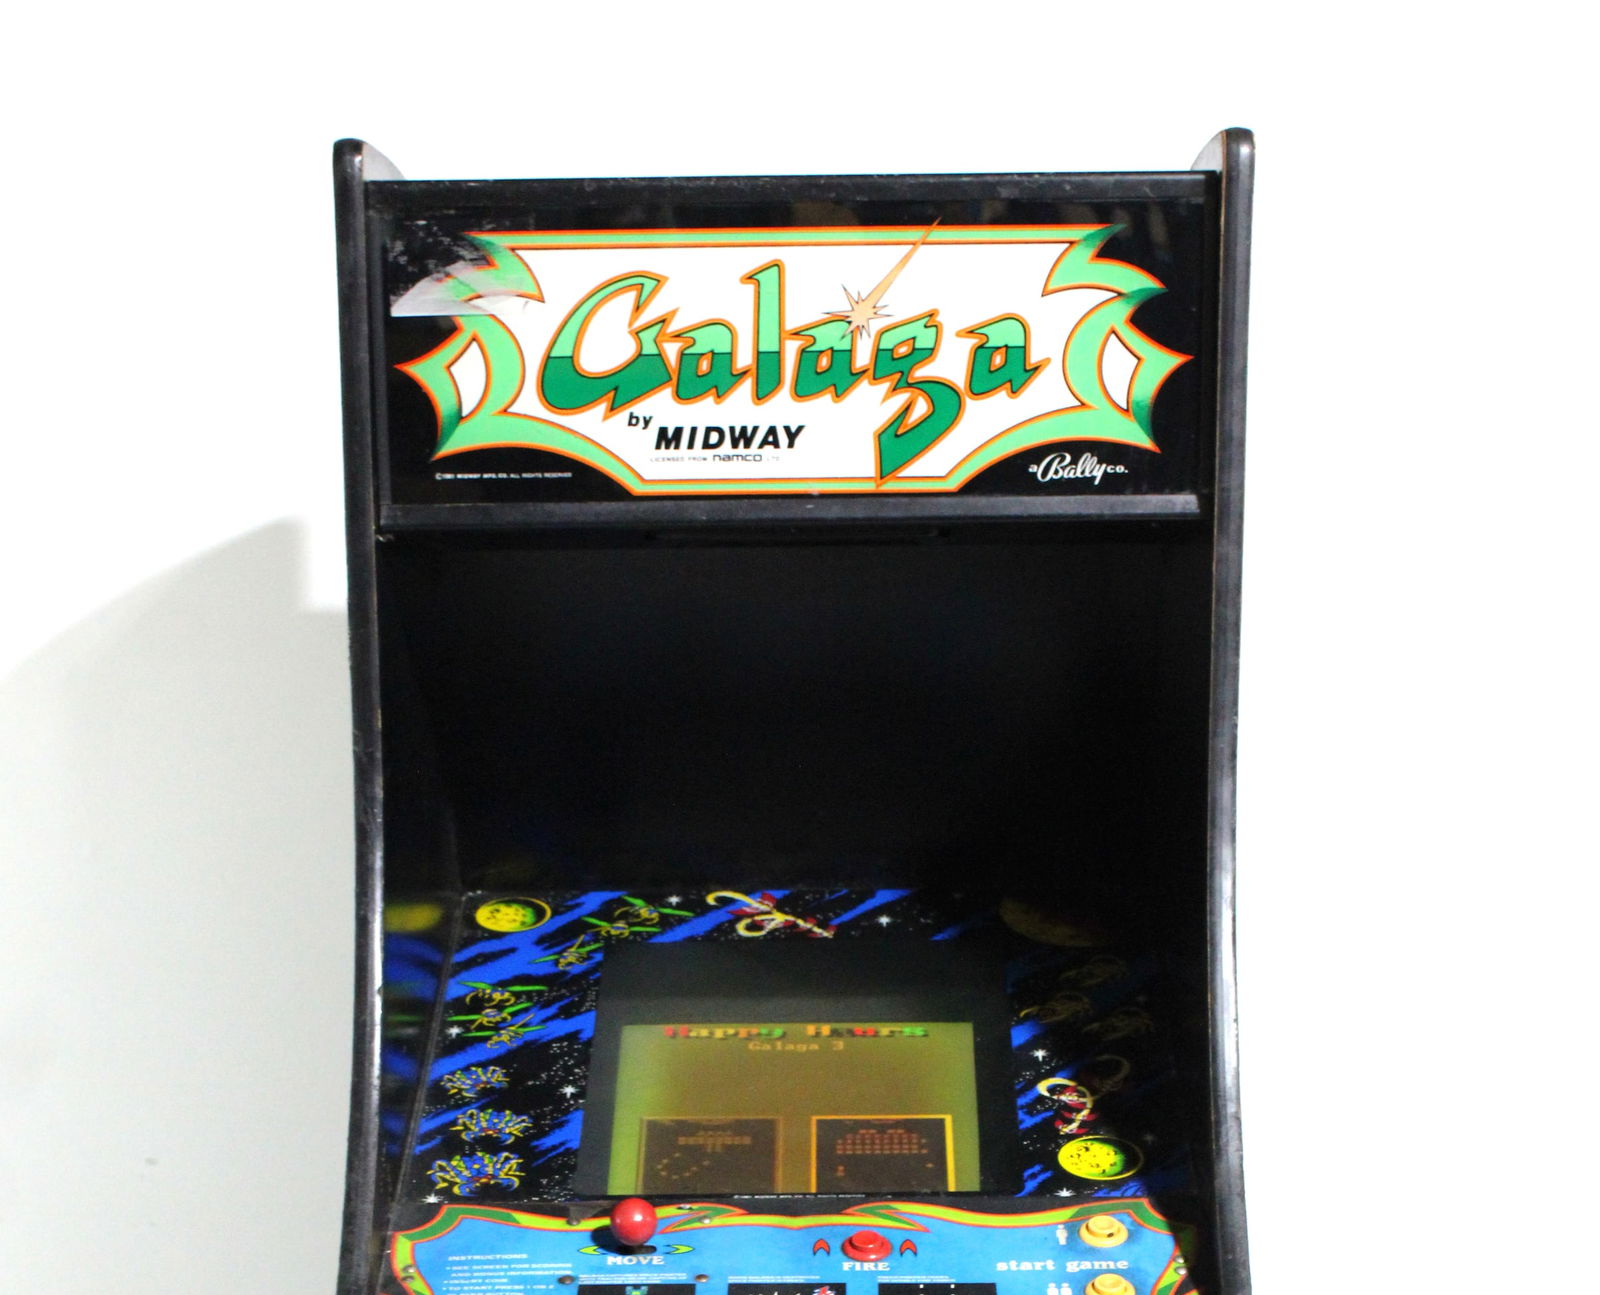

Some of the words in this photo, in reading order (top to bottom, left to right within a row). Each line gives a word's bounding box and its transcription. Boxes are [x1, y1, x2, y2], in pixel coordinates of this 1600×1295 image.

[537, 259, 1052, 487] Galaga
[627, 412, 653, 430] by
[655, 425, 806, 450] MIDWAY
[712, 454, 763, 463] namco
[1037, 452, 1107, 485] Bally
[664, 1026, 784, 1039] Happy
[748, 1040, 819, 1052] Galaga
[607, 1255, 665, 1266] MOVE
[842, 1261, 890, 1272] FIRE
[996, 1259, 1055, 1272] start
[1065, 1260, 1129, 1273] game
